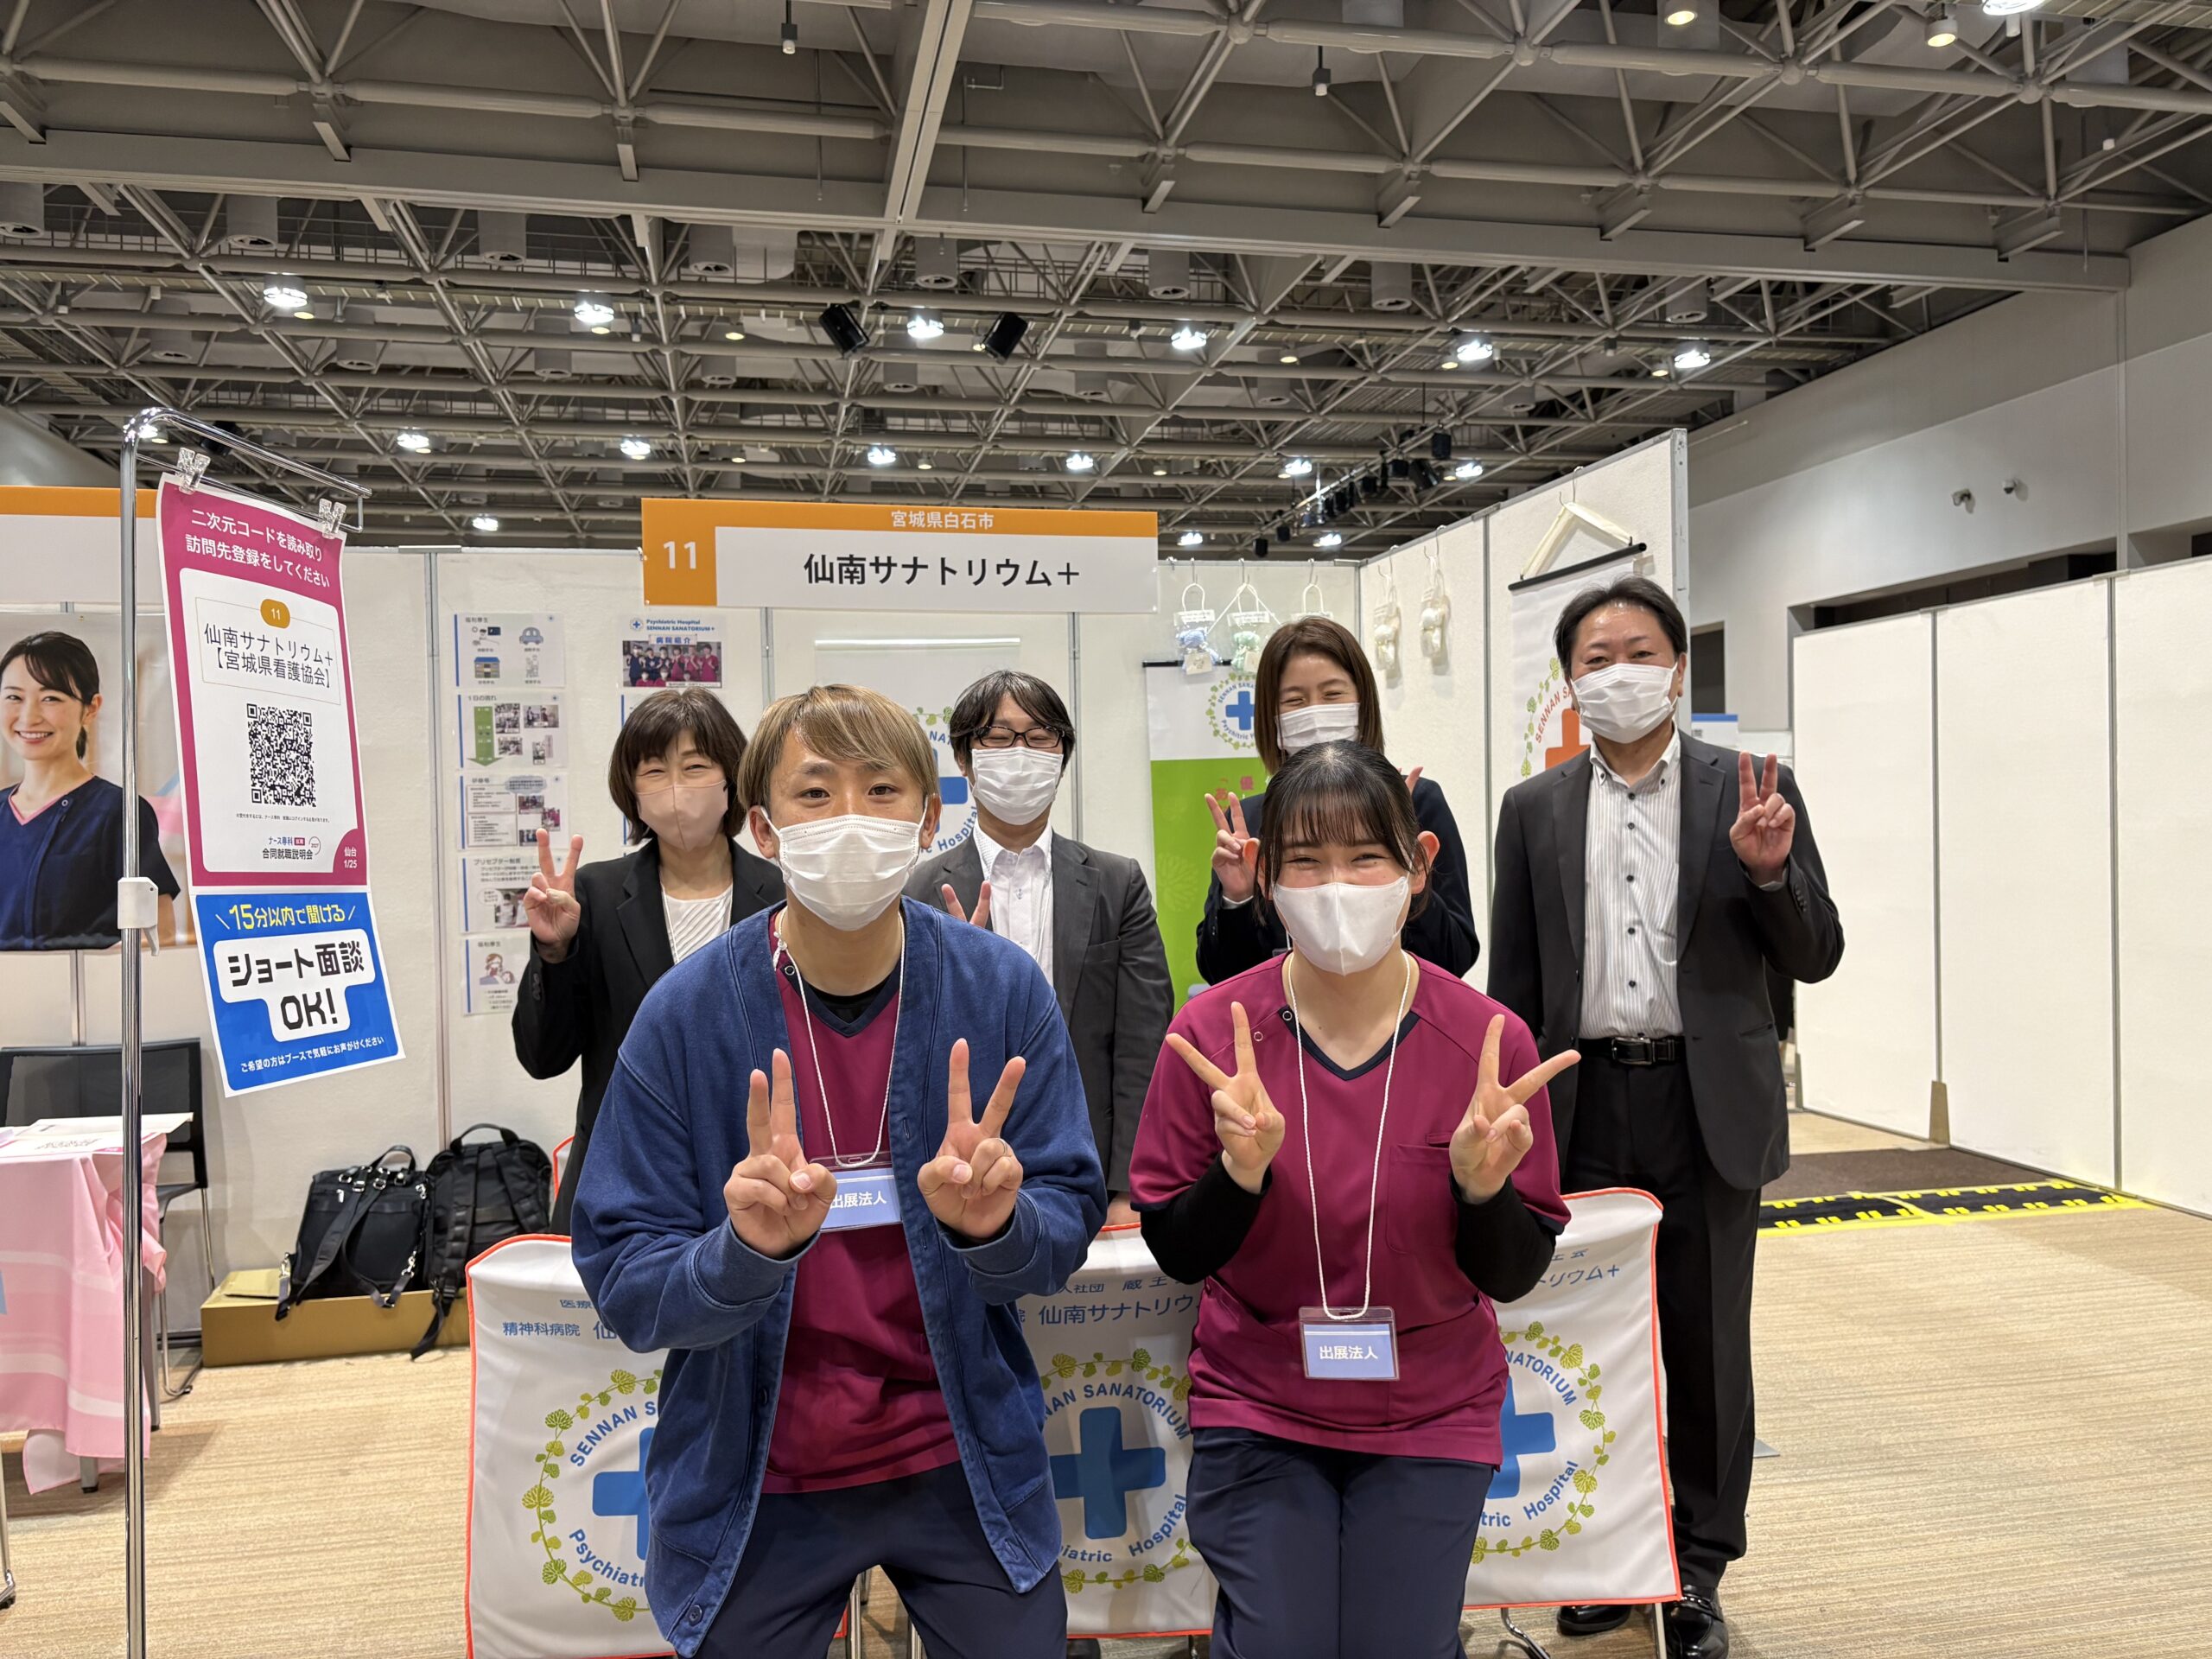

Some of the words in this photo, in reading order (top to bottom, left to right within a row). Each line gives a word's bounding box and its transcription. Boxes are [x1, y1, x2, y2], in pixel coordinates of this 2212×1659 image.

[192, 509, 322, 562] 二次元コードを読み取り
[891, 511, 995, 529] 宮城県白石市
[185, 534, 330, 588] 訪問先登録をしてください
[663, 541, 697, 569] 11
[270, 607, 282, 620] 11
[217, 647, 330, 688] 【宮城県看護協会】
[1535, 691, 1560, 743] SENNAN
[262, 848, 314, 860] 合同就職説明会
[269, 836, 293, 846] ナース専科
[344, 846, 357, 857] 仙台
[344, 860, 357, 869] 1/25
[229, 904, 346, 930] 15分以内で聞ける
[228, 941, 365, 987] ショート面談
[280, 988, 338, 1030] OK!
[240, 1037, 385, 1072] ご希望の方はブースで気軽にお声がけください
[830, 1191, 887, 1210] 出展法人
[1039, 1294, 1198, 1325] 仙南サナトリウ
[502, 1322, 581, 1337] 精神科病院
[1319, 1345, 1379, 1360] 出展法人
[1084, 1382, 1191, 1440] SANATORIUM
[570, 1406, 638, 1467] SENNAN
[1523, 1460, 1580, 1520] Hospital
[1061, 1545, 1113, 1562] iatric
[1128, 1494, 1186, 1557] Hospital
